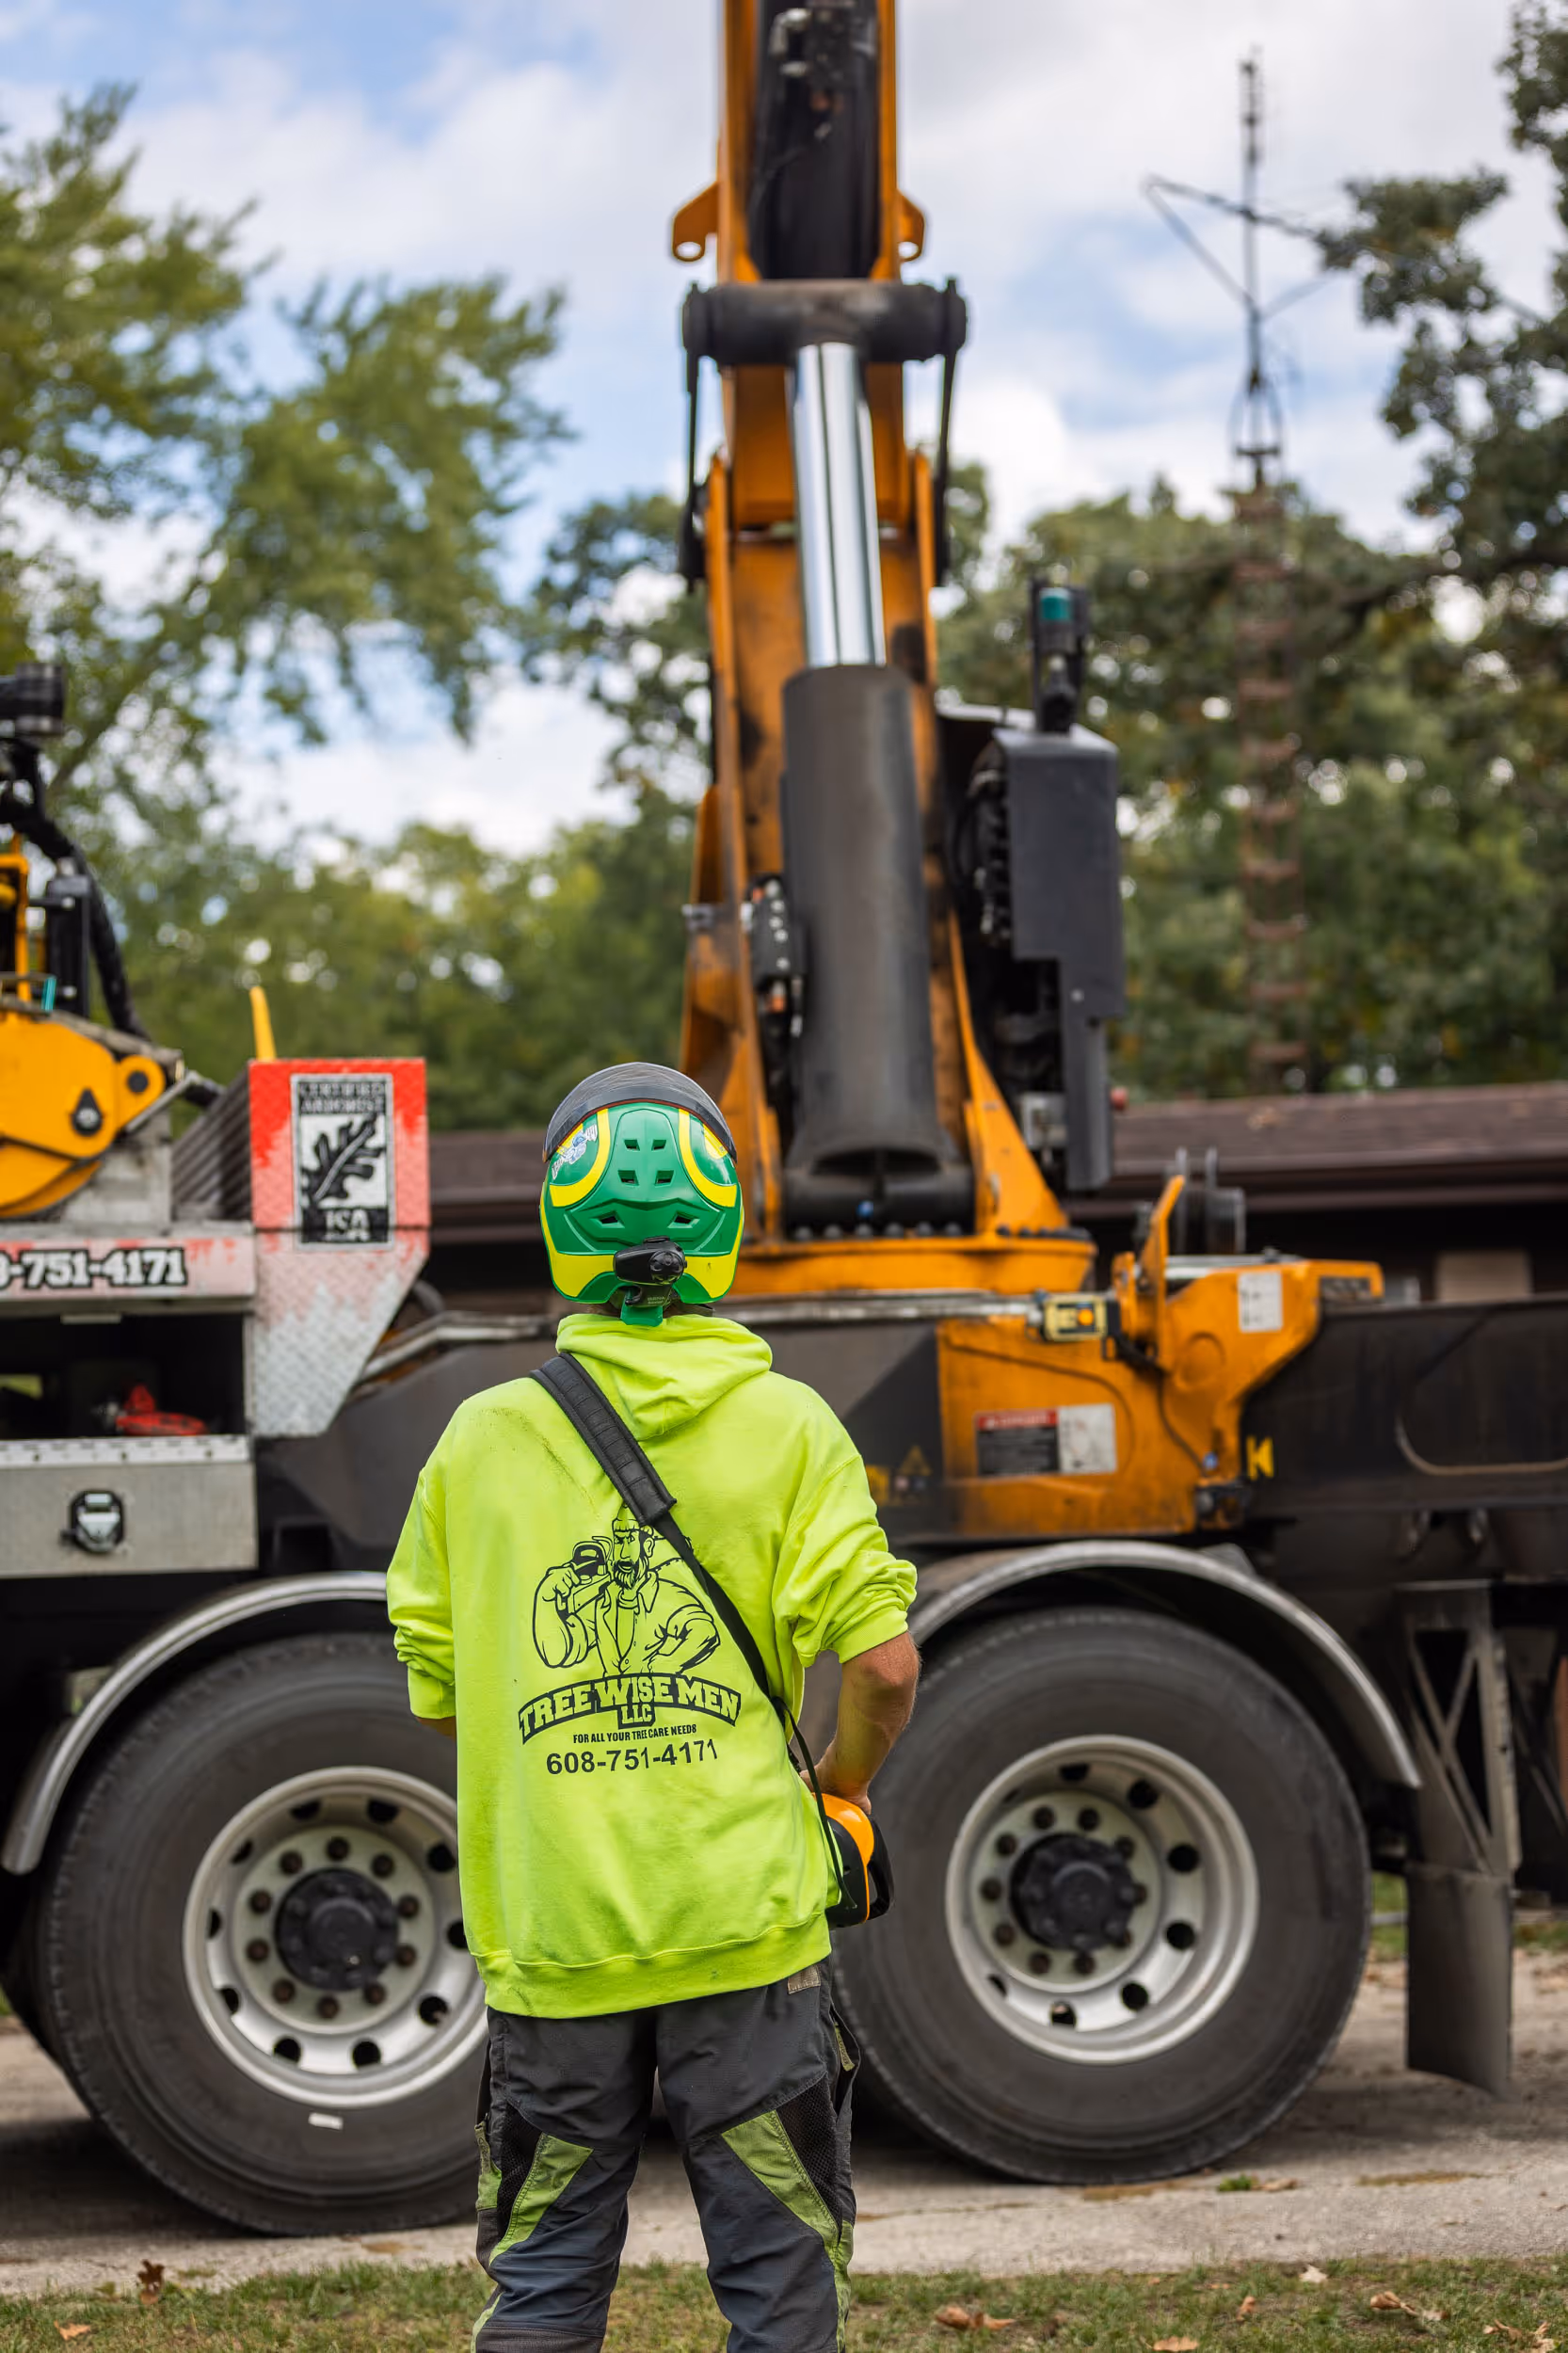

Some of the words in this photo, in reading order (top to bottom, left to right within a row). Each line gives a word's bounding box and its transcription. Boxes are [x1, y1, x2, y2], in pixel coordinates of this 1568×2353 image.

[323, 1209, 372, 1242] ISA
[519, 1682, 594, 1741] TREE
[595, 1674, 675, 1708] WISE
[676, 1675, 740, 1723] MEN
[620, 1704, 653, 1725] LLC
[572, 1734, 589, 1744] FOR
[590, 1733, 605, 1743] ALL
[606, 1731, 631, 1742] YOUR
[632, 1729, 648, 1740] TREE
[648, 1727, 669, 1738] CARE
[670, 1723, 697, 1736] NEEDS
[546, 1737, 719, 1775] 608-751-4171
